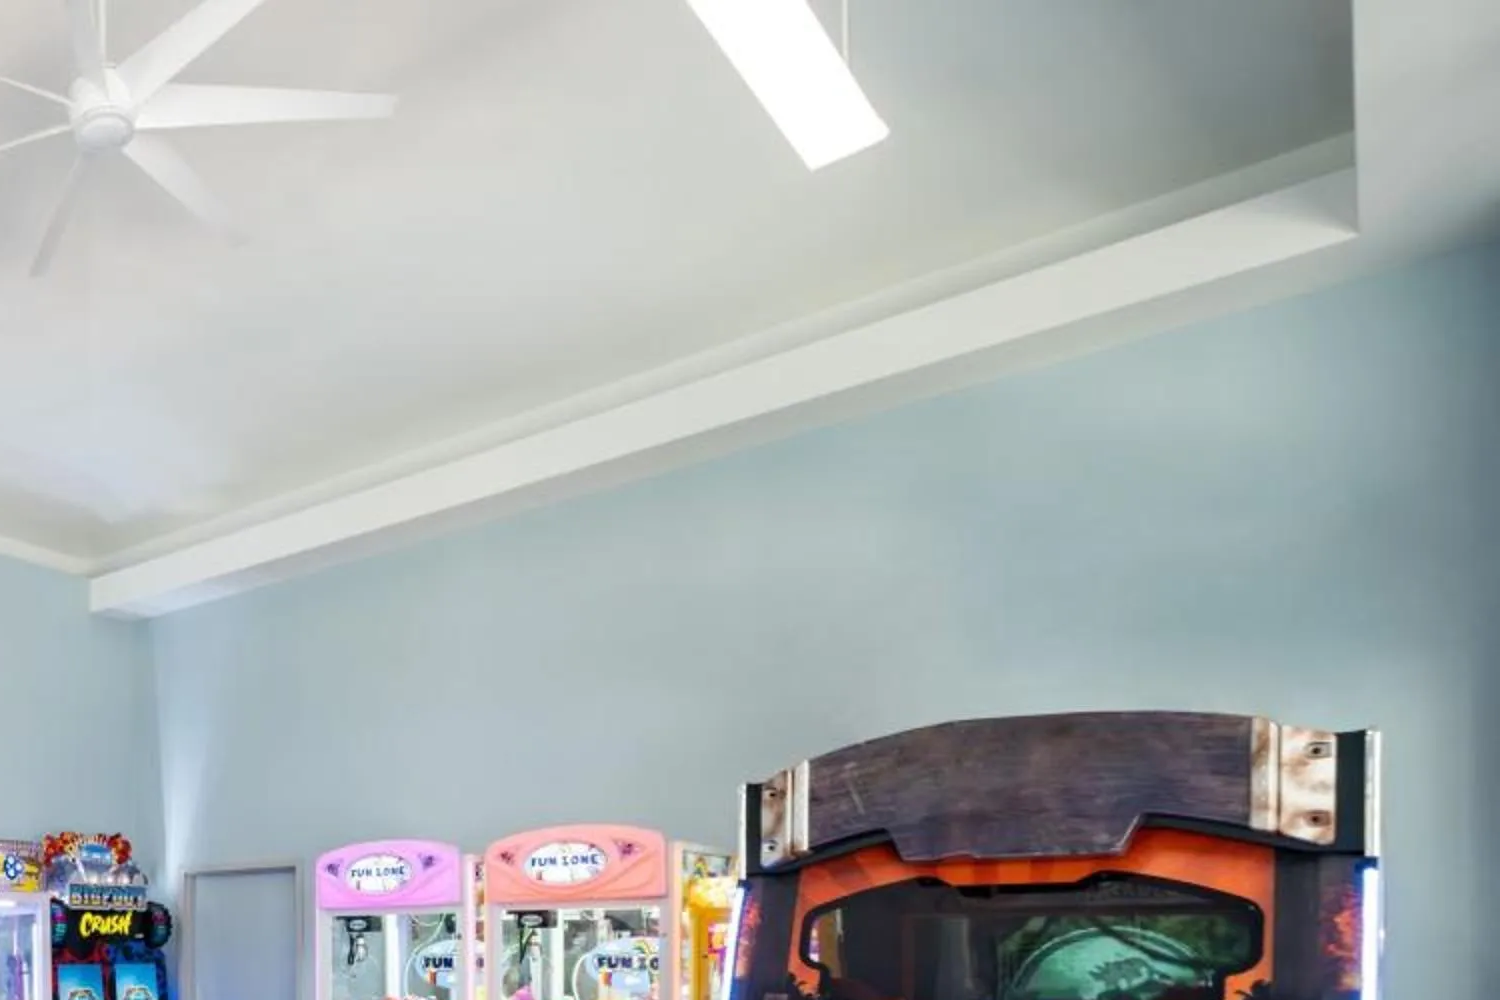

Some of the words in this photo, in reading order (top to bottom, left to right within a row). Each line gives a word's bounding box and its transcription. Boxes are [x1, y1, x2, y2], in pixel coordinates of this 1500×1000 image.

[531, 855, 558, 867] FUN
[80, 909, 133, 938] CRUSH
[597, 956, 633, 969] FUN
